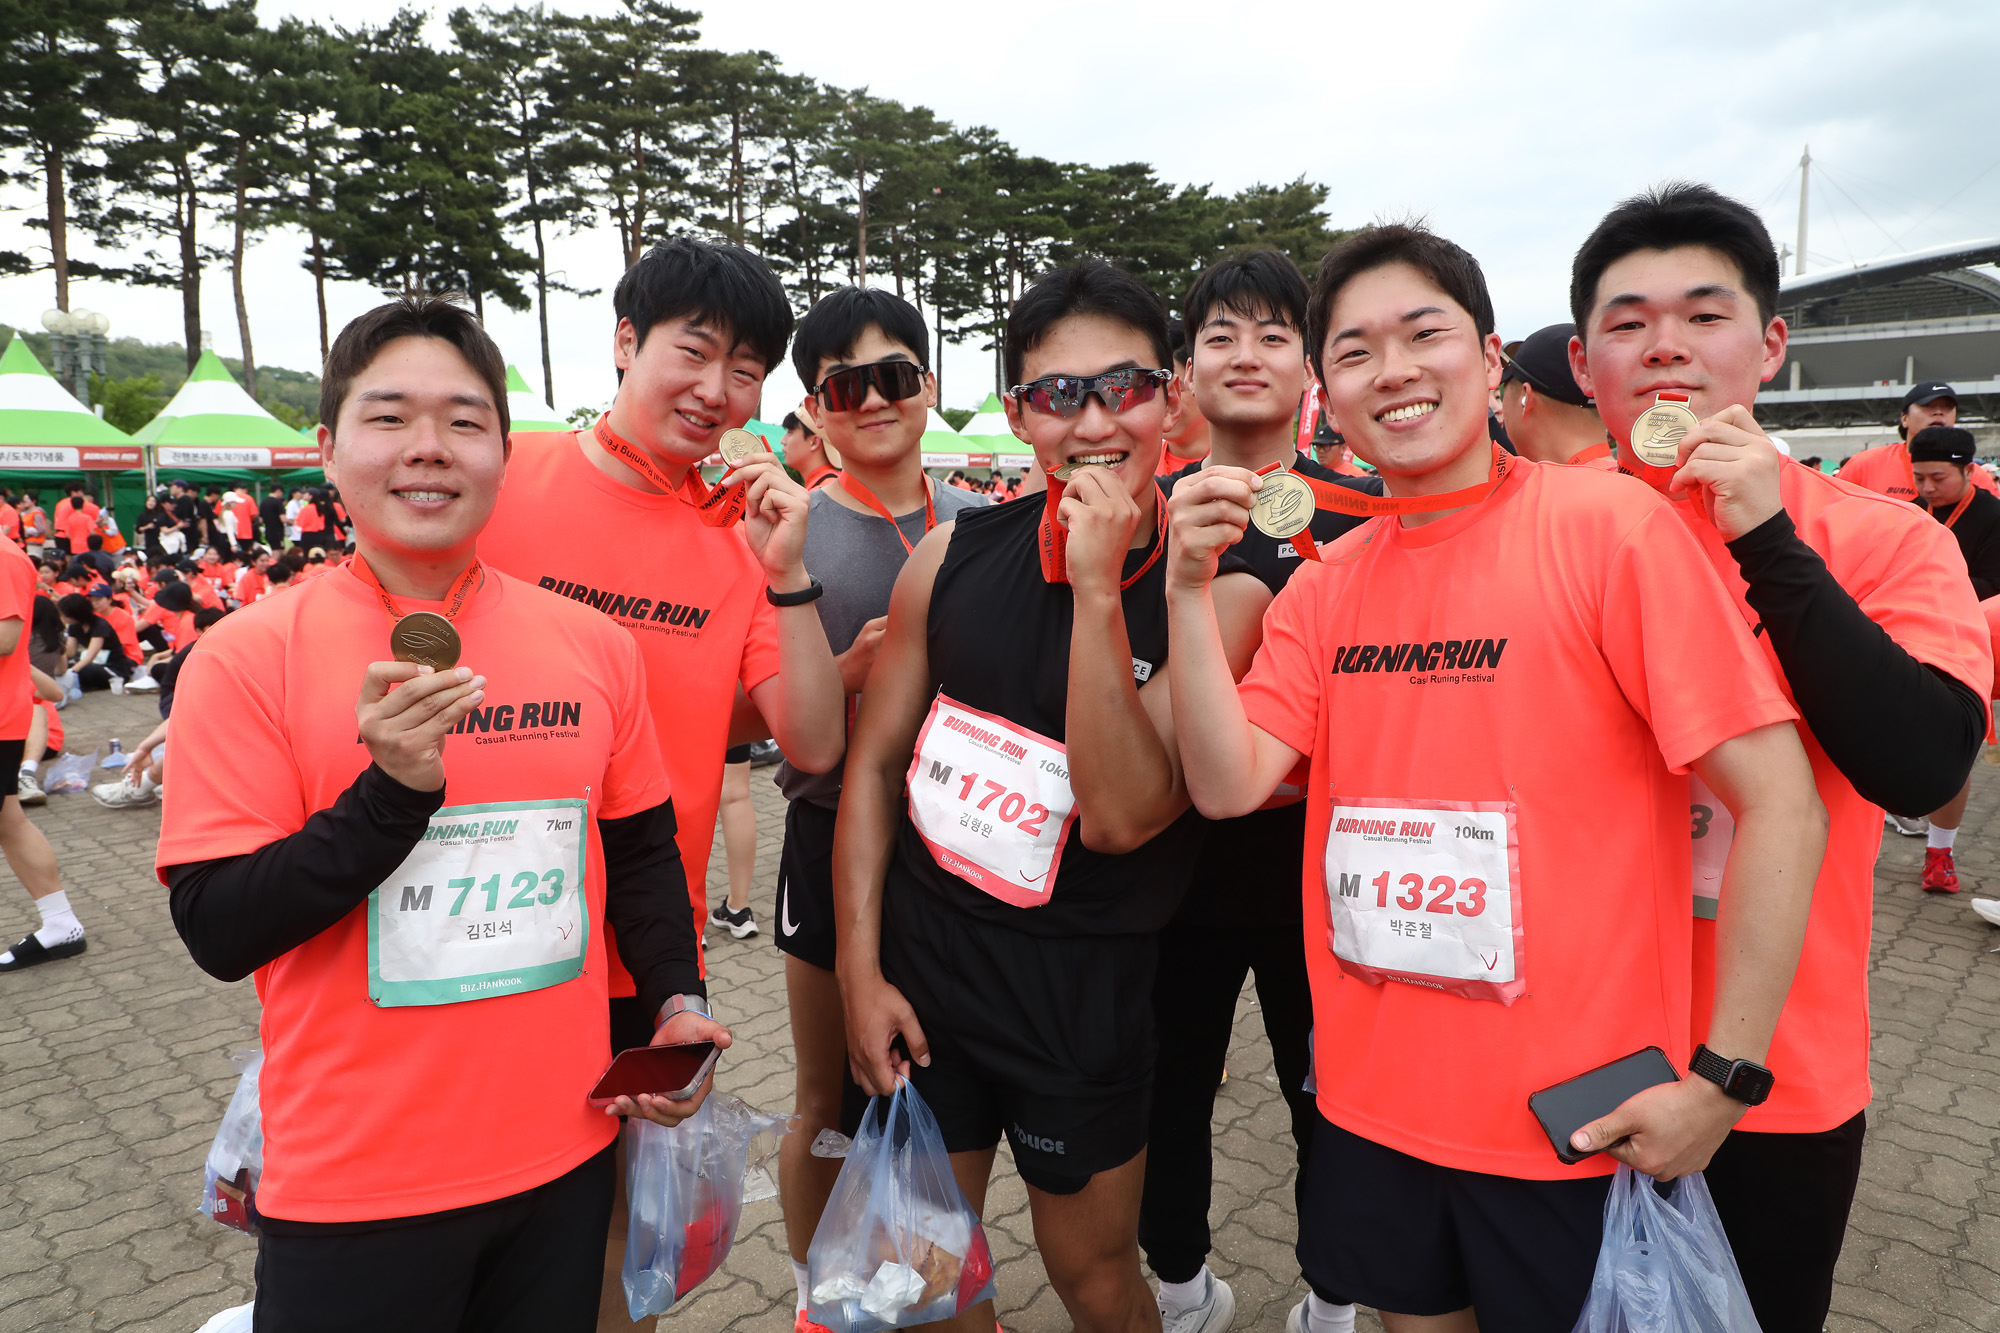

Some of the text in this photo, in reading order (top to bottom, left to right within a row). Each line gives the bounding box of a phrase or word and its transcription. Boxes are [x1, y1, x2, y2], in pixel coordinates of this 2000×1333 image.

[650, 600, 711, 629] RUN
[639, 622, 670, 635] Running
[672, 628, 700, 639] Festival
[1461, 673, 1495, 684] Festival
[518, 700, 582, 730] RUN
[475, 729, 581, 746] Casual Running Festival
[942, 715, 1001, 748] BURNING
[999, 739, 1028, 761] RUN
[967, 738, 984, 751] Casual
[1003, 753, 1022, 766] Festival
[928, 760, 1050, 838] M 1702
[419, 819, 573, 842] RNING RUN 7km
[439, 838, 464, 846] Casual
[489, 834, 515, 842] Festival
[1335, 817, 1495, 841] BURNING RUN 10km
[1363, 834, 1432, 845] Casual Running Festival
[399, 868, 565, 916] M 7123
[1339, 870, 1488, 918] M 1323
[466, 919, 513, 941] 김진석
[1389, 919, 1433, 940] 박준철
[1013, 1121, 1065, 1155] POLICE
